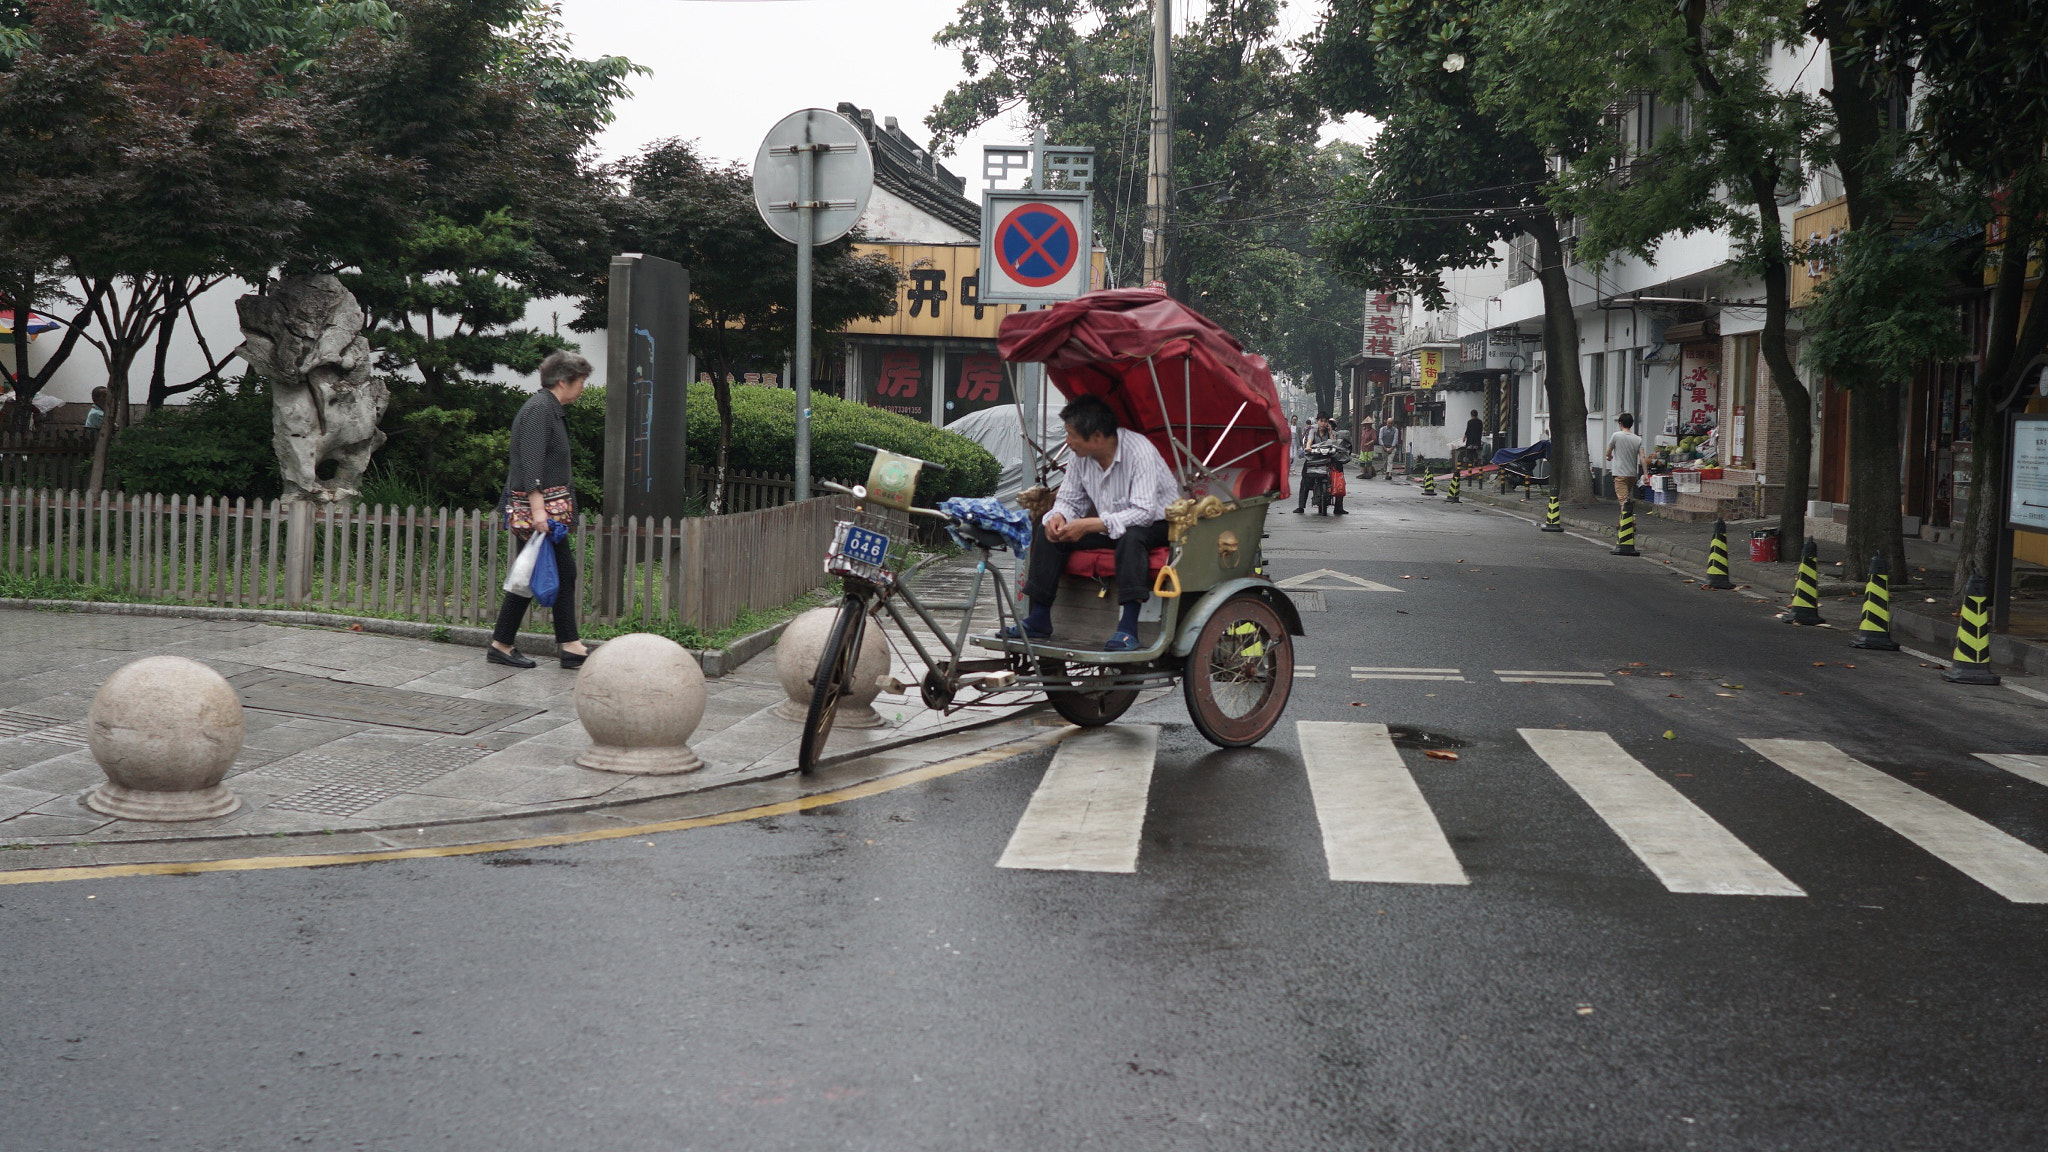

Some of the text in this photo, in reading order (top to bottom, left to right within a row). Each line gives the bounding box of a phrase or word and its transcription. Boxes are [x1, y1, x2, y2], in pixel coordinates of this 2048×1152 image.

[1366, 279, 1398, 356] 香客栈
[877, 350, 921, 398] 房
[956, 350, 1003, 401] 房
[1425, 352, 1437, 378] 后街
[1690, 366, 1709, 425] 水果店
[850, 538, 880, 556] 046
